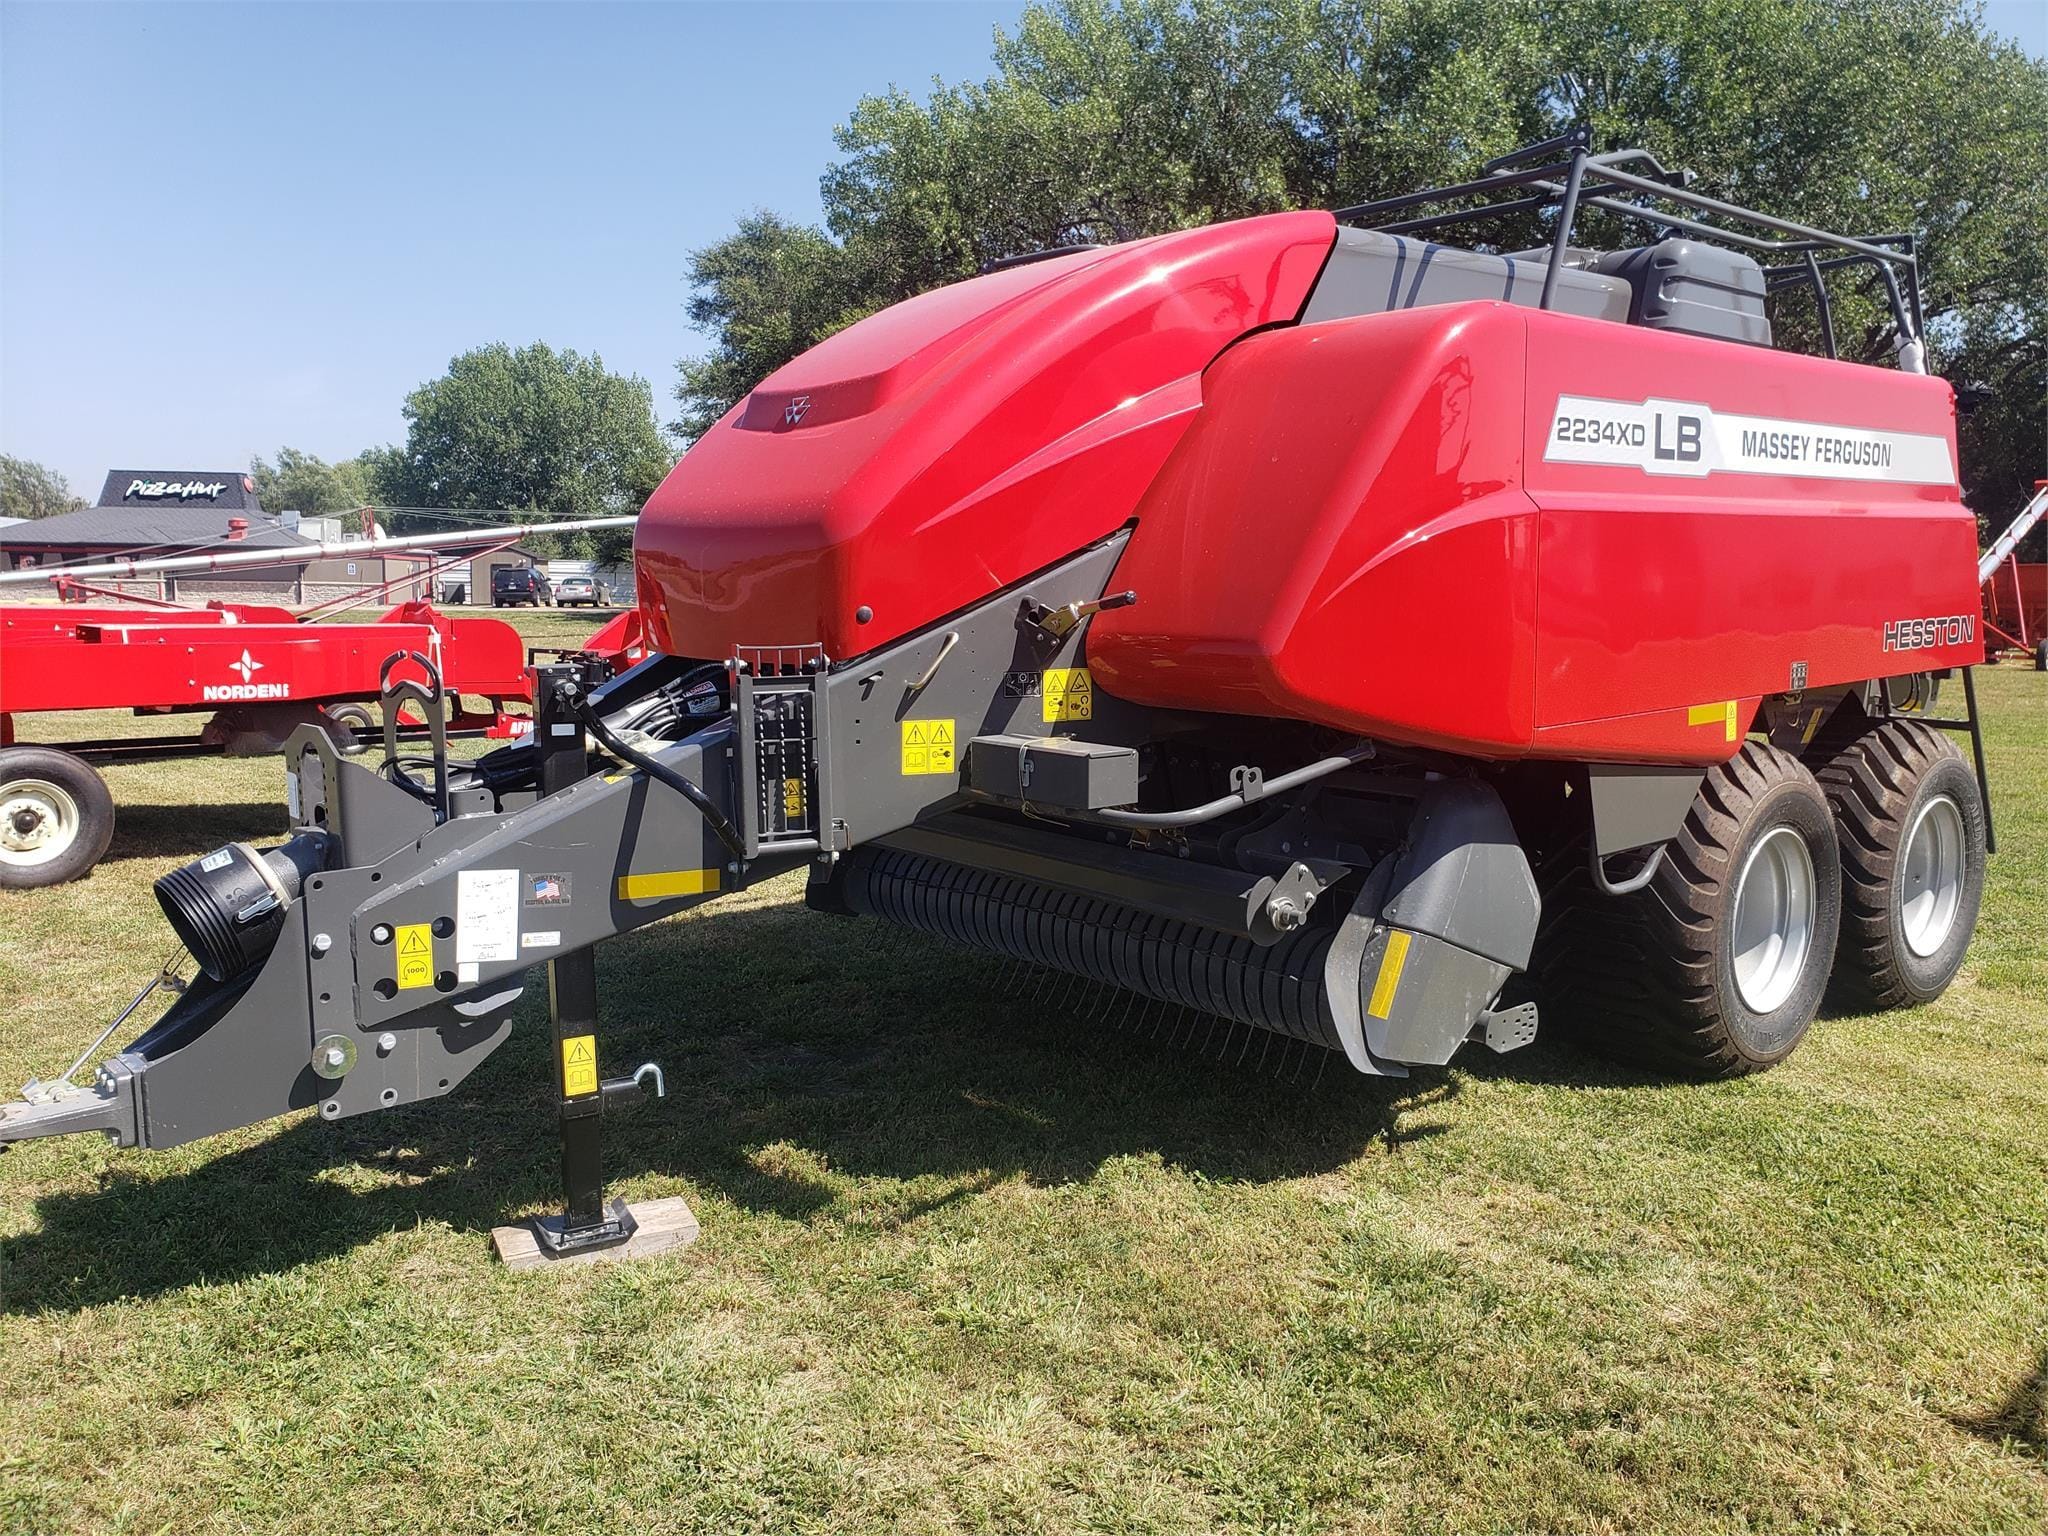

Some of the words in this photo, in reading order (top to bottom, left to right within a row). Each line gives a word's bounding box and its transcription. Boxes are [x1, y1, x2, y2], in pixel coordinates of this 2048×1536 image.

[1556, 416, 1646, 447] 2234XD
[1653, 412, 1702, 463] LB
[1741, 429, 1811, 462] MASSEY
[1814, 436, 1892, 468] FERGUSON
[125, 478, 184, 497] Pizza
[181, 480, 228, 498] Hut
[1882, 614, 1976, 653] HESSTON
[203, 683, 283, 701] NORDEN
[407, 966, 425, 975] 1000
